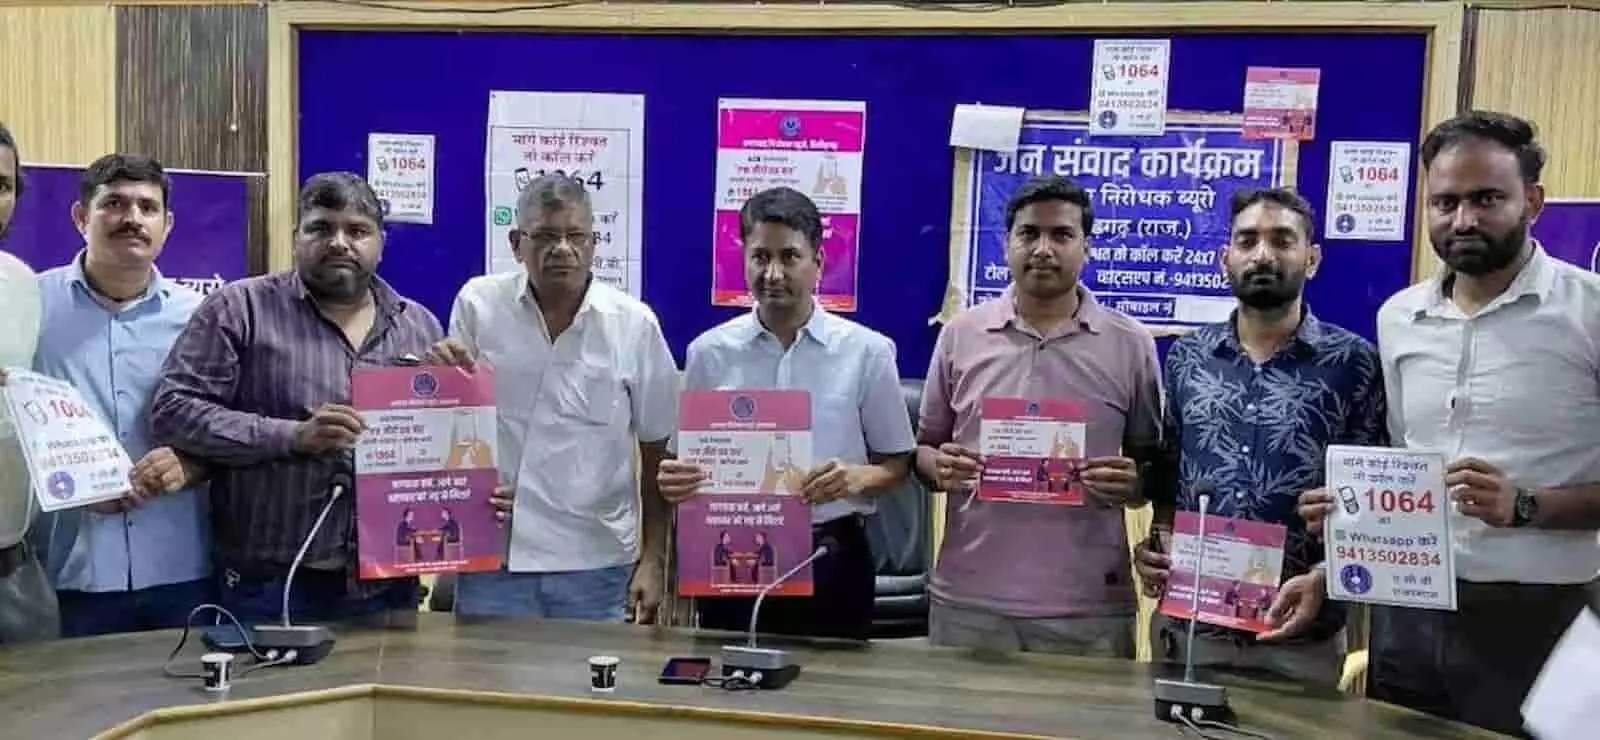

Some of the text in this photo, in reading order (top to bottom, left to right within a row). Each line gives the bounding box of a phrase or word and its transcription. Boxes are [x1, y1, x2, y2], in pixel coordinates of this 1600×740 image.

[1118, 64, 1159, 78] 1064
[540, 131, 566, 147] कोई
[1052, 138, 1135, 177] संवाद
[1139, 137, 1265, 181] कार्यक्रम
[1357, 166, 1399, 181] 1064
[1100, 183, 1174, 208] निरोधक
[1175, 185, 1216, 213] ब्यूरो
[1137, 217, 1191, 241] (राज.)
[1130, 244, 1158, 263] कॉल
[1364, 487, 1435, 513] 1064
[1349, 531, 1414, 547] Whatsapp
[1335, 546, 1441, 566] 9413502834
